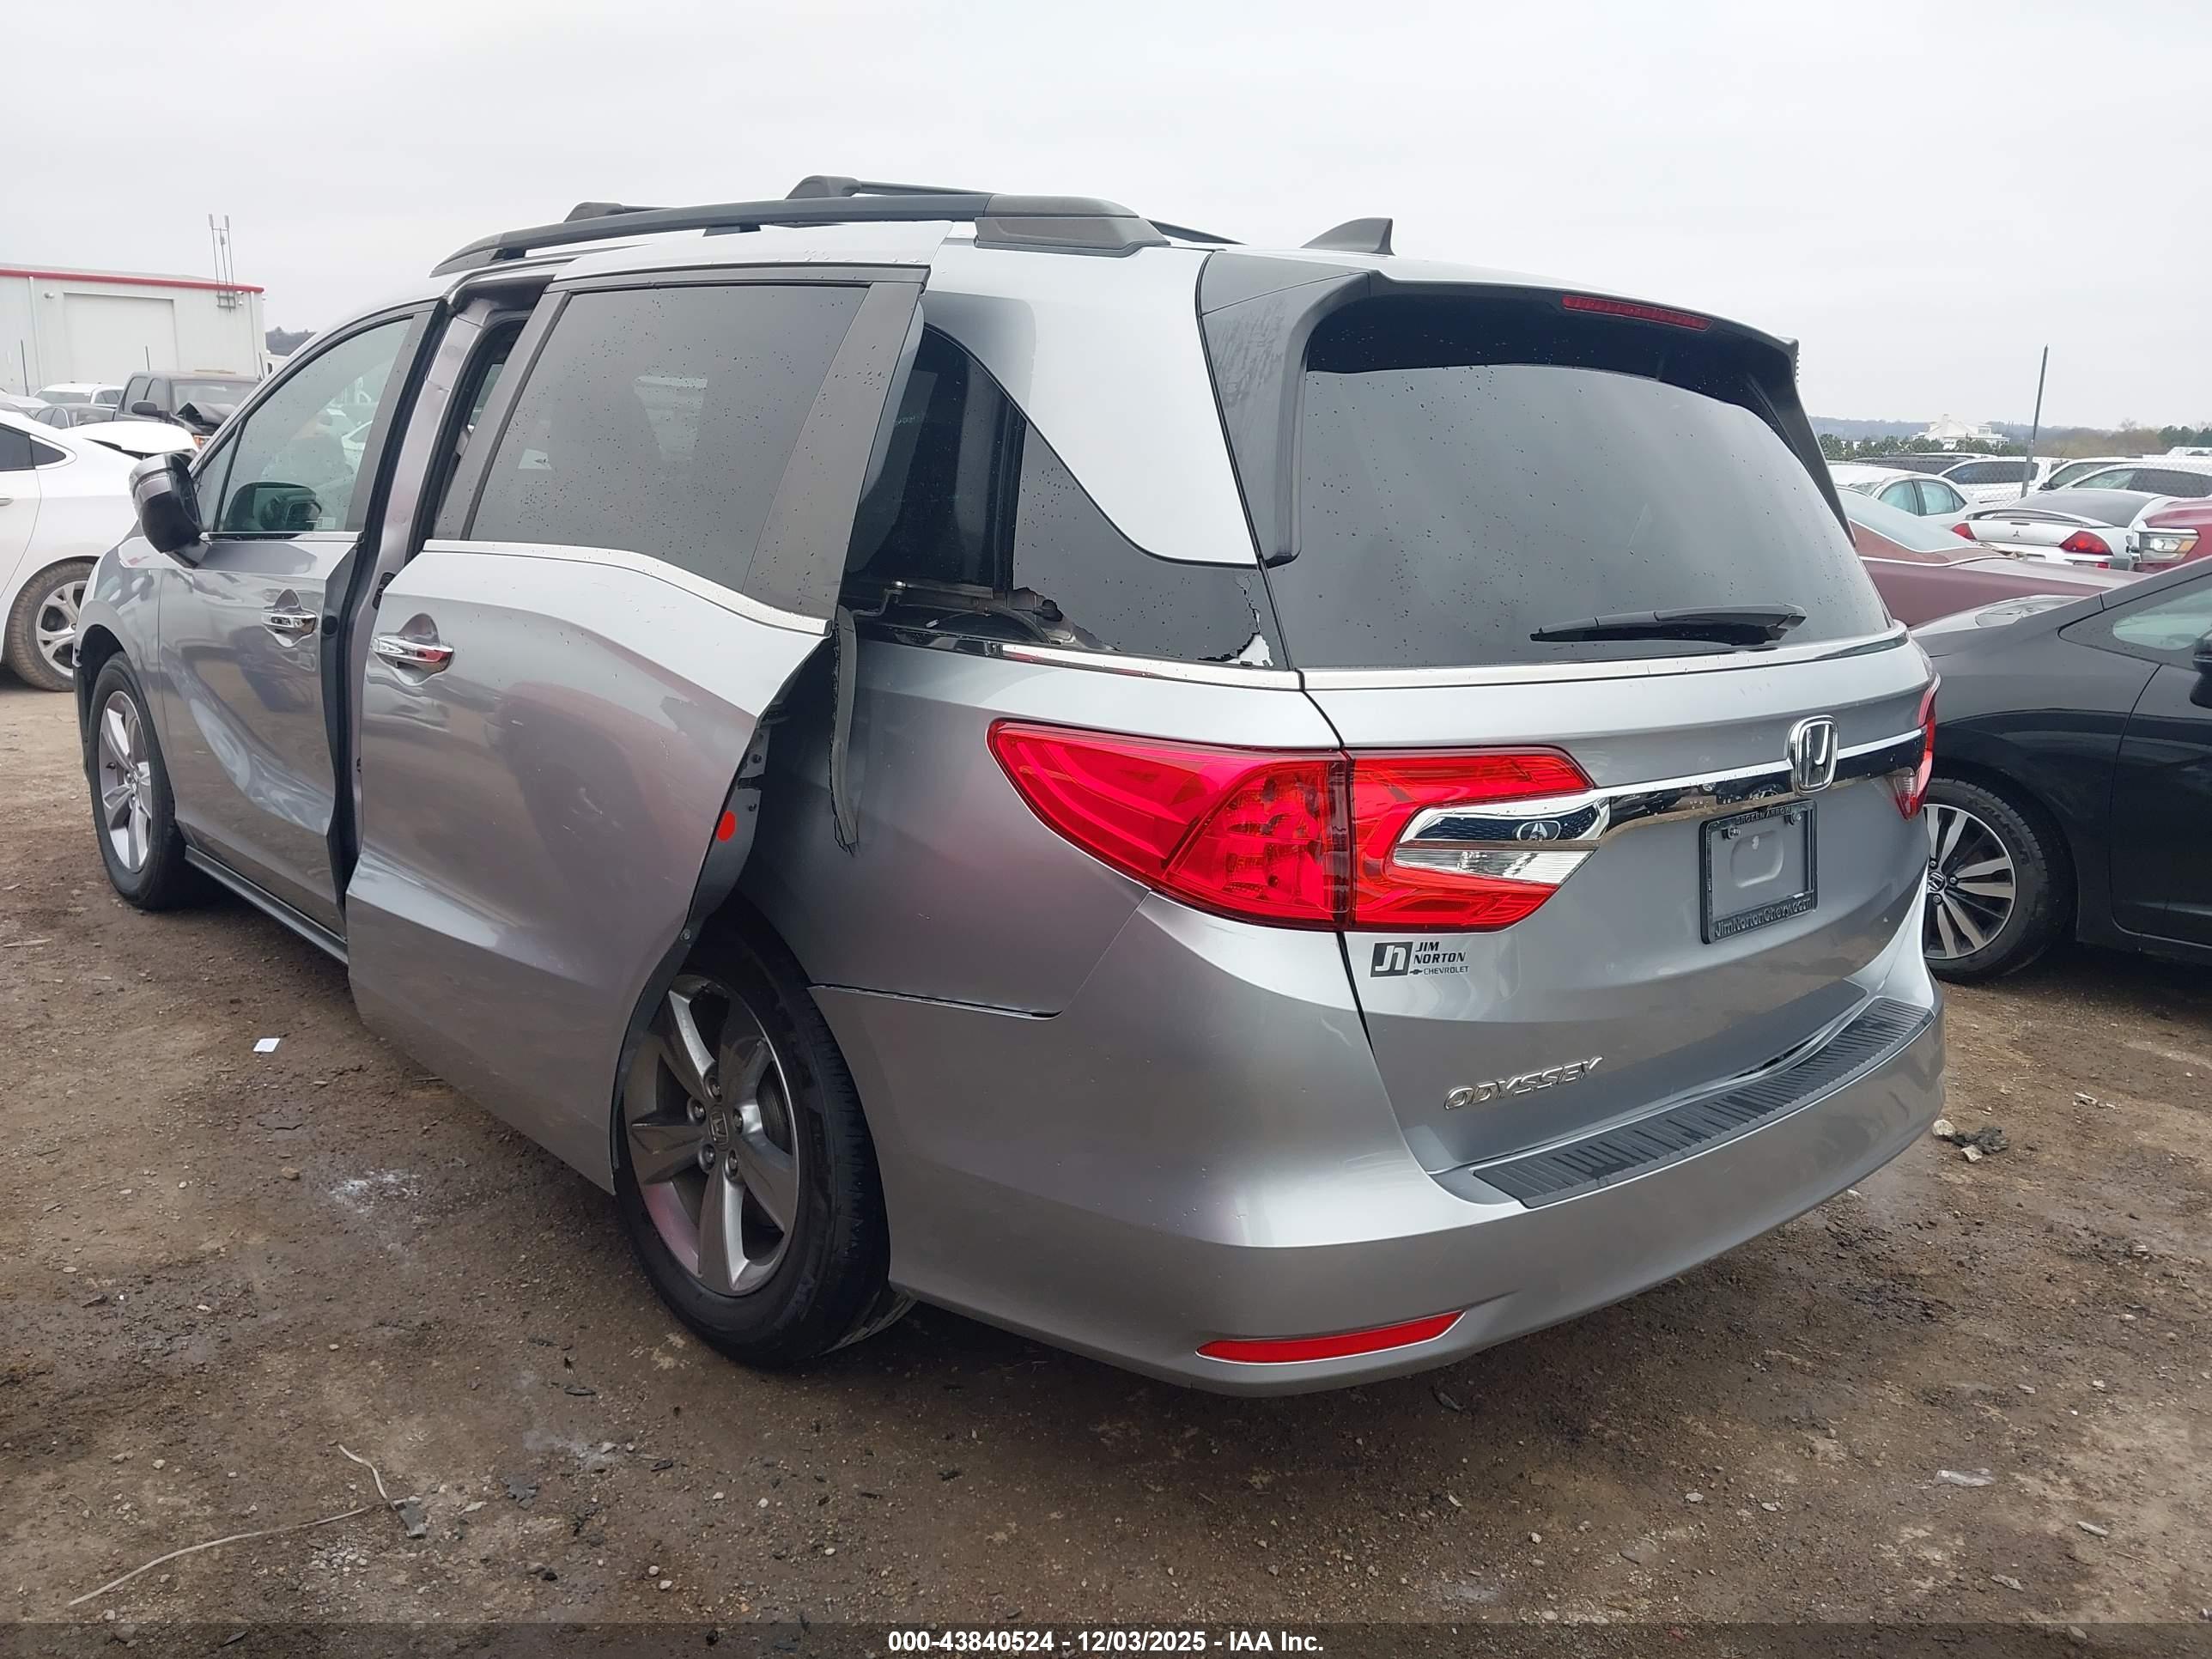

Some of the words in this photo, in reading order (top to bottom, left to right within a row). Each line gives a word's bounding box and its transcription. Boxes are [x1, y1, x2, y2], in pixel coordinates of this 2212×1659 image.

[1415, 941, 1440, 952] JIM
[1413, 951, 1467, 964] NORTON
[1423, 965, 1469, 975] CHEVROLET
[1444, 1055, 1604, 1110] ODYSSEY
